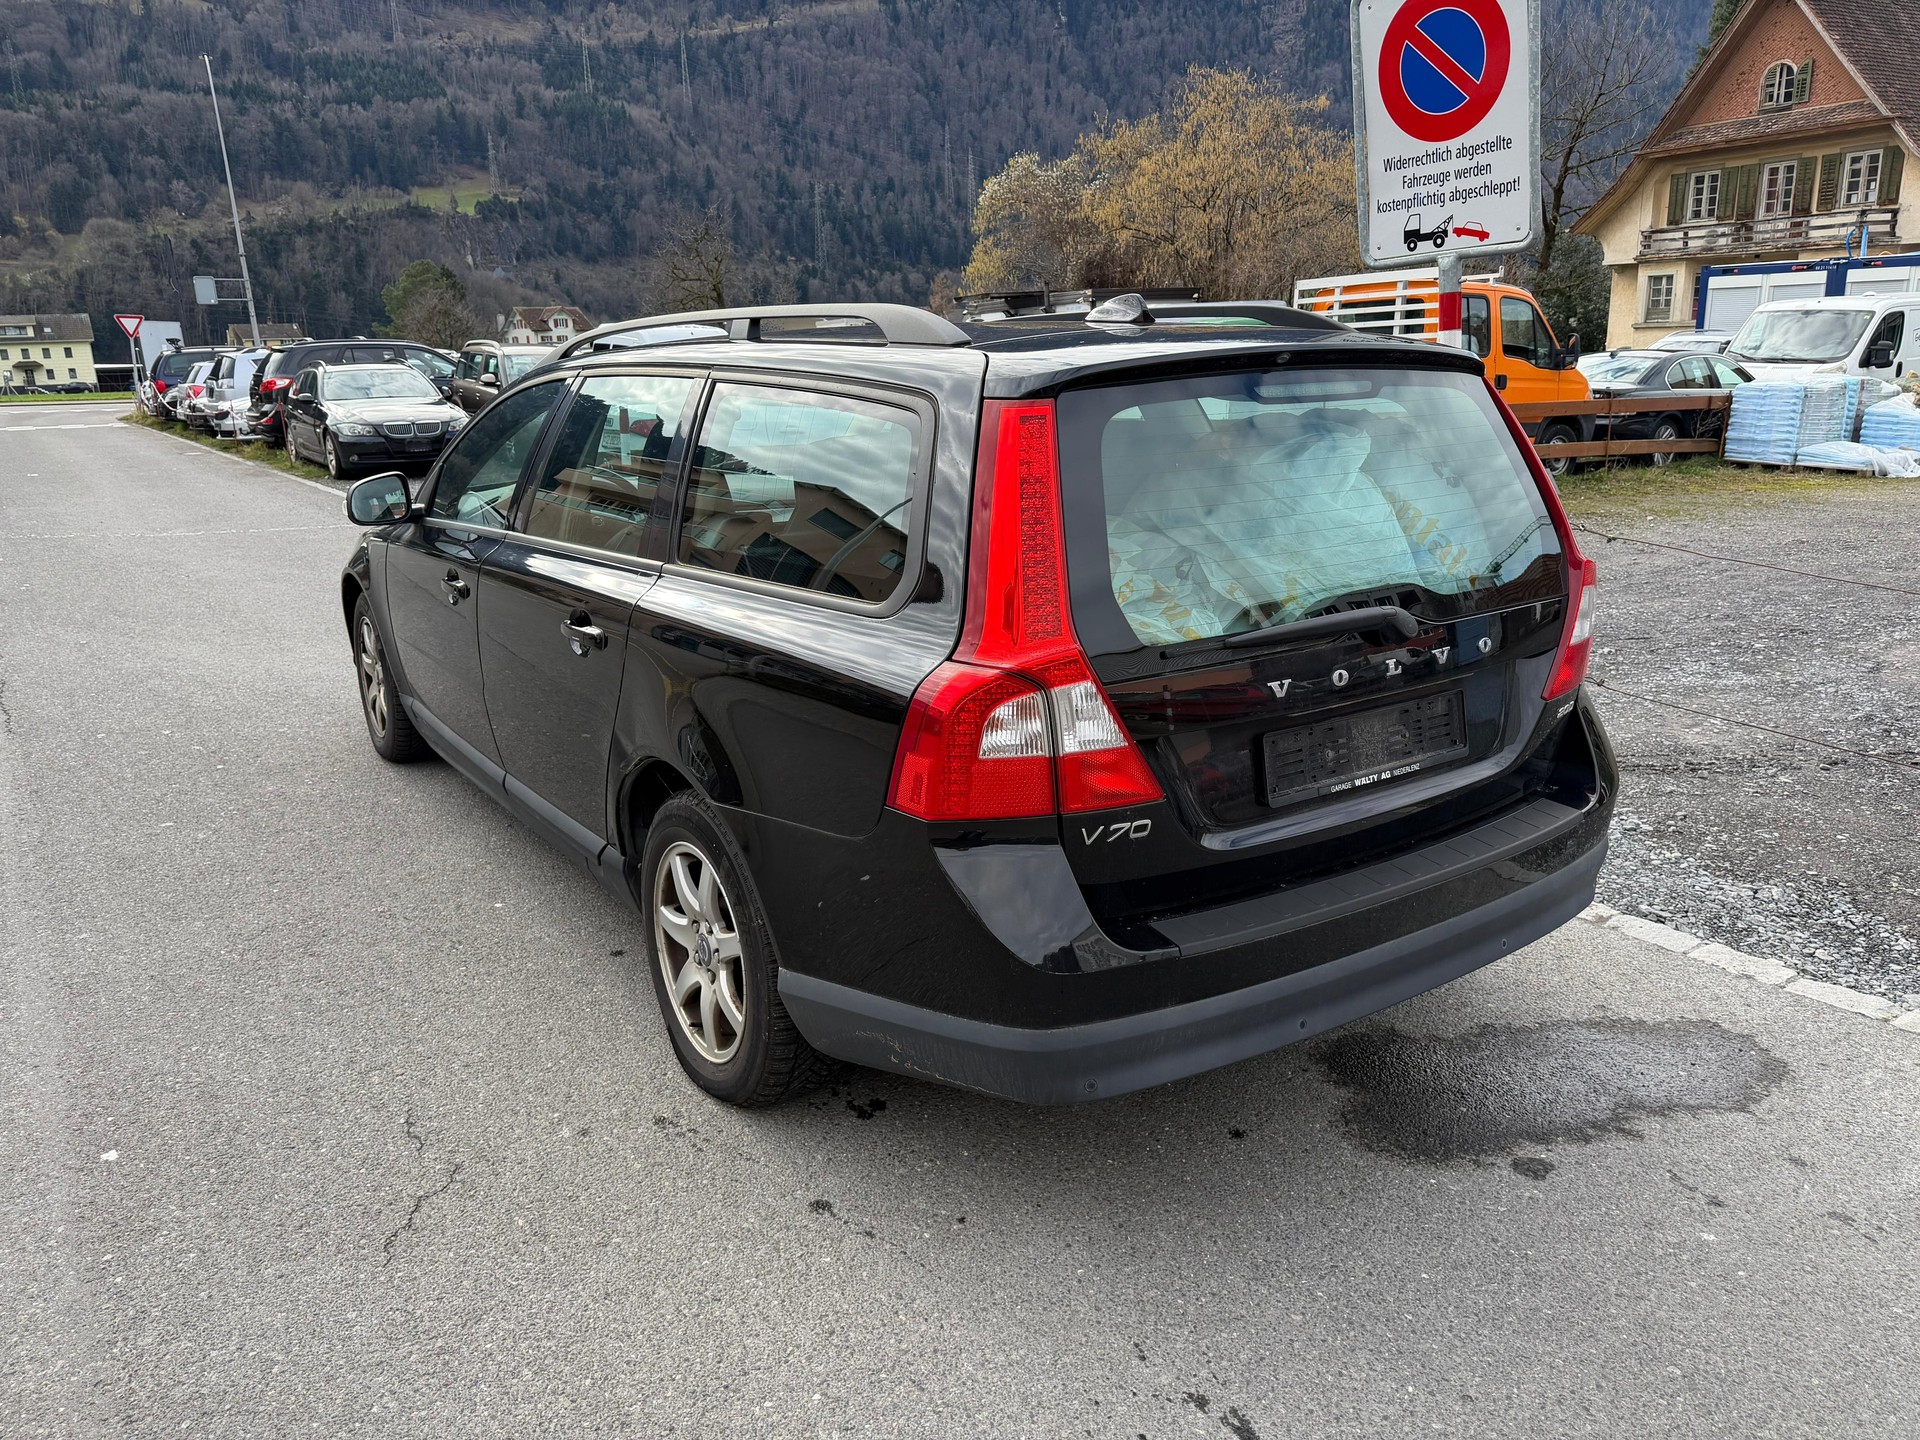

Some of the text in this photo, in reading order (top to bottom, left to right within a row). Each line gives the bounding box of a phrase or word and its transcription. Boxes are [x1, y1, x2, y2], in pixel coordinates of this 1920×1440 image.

[1383, 135, 1512, 172] Widerrechtlich abgestellte
[1402, 161, 1492, 189] Fahrzeuge werden
[1377, 176, 1520, 213] kostenpflichtig abgeschleppt!
[1267, 637, 1492, 698] VOLVO
[1330, 781, 1352, 793] GARAGE
[1380, 770, 1391, 780] AG
[1081, 819, 1152, 845] V70
